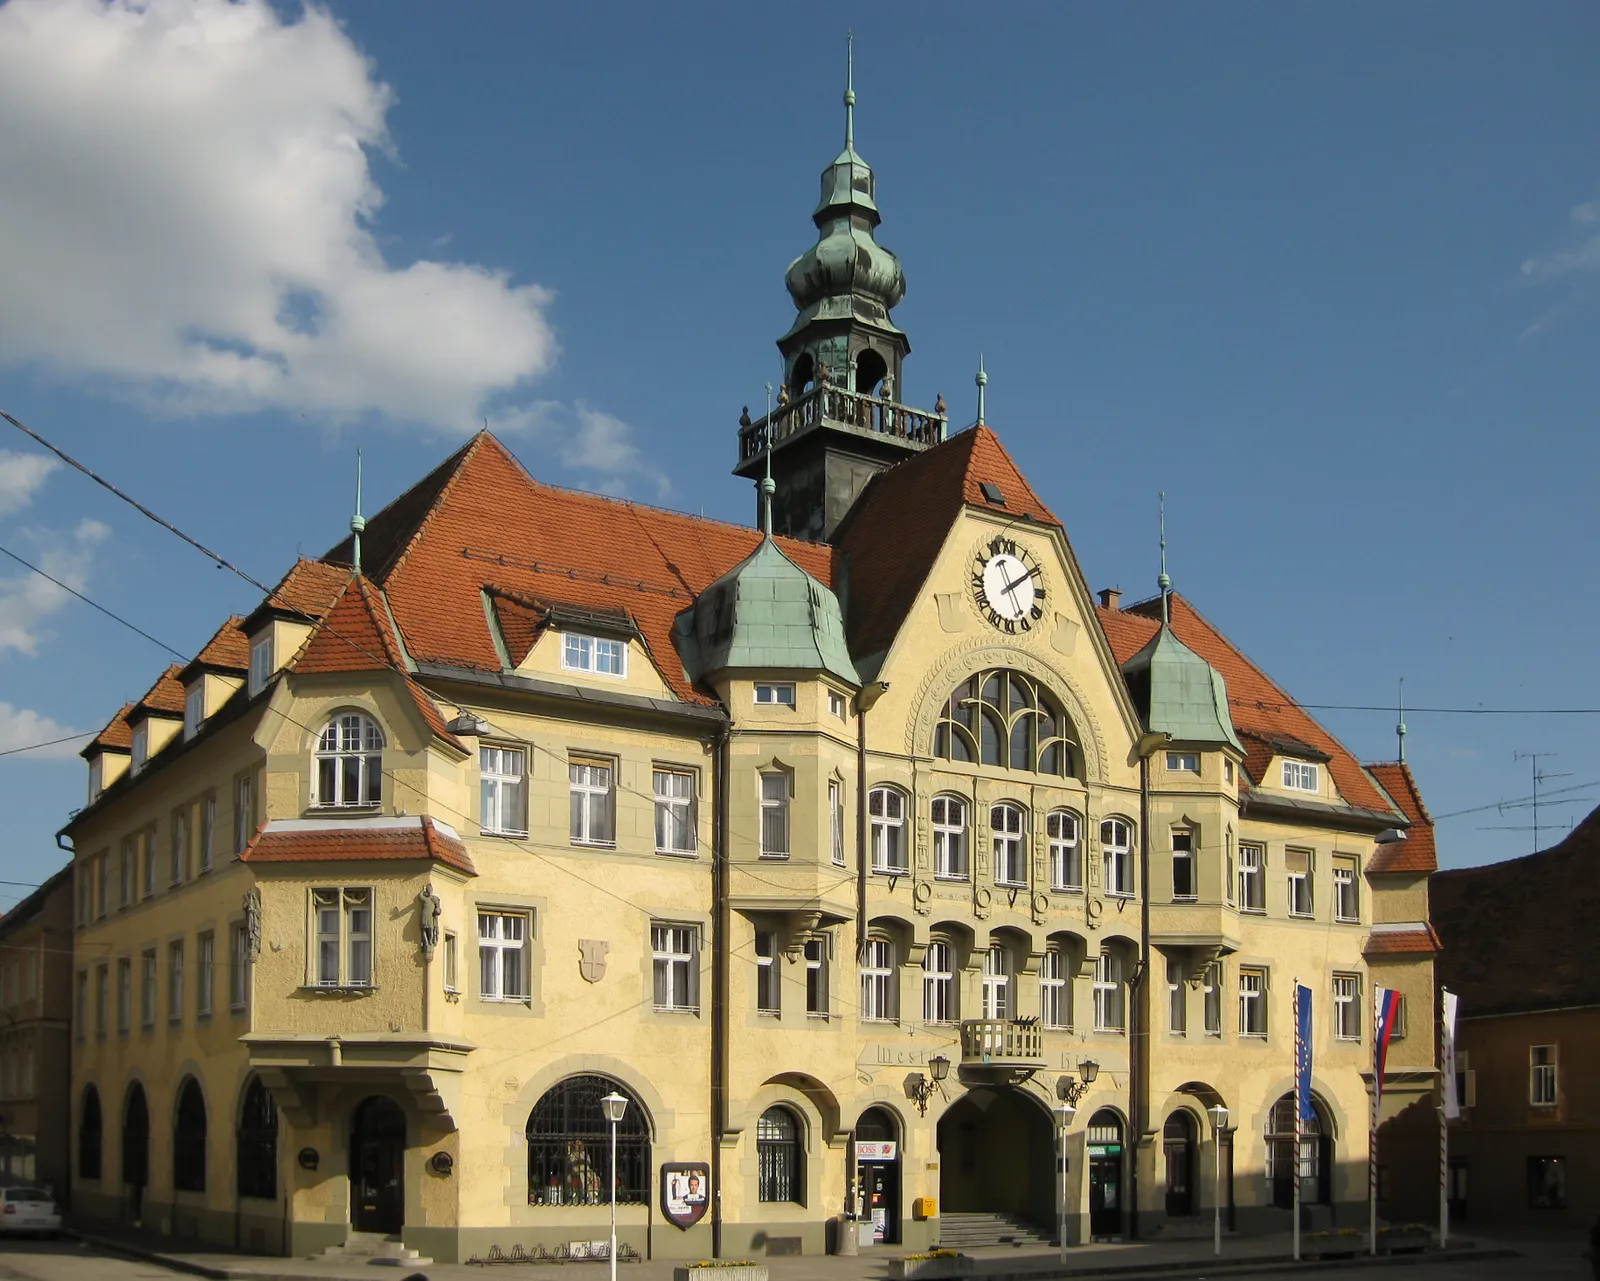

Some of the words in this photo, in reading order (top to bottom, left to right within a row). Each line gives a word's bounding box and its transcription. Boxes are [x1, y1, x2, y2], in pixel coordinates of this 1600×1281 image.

[1003, 539, 1016, 556] XII
[976, 551, 989, 568] X
[972, 571, 985, 588] IX
[1034, 588, 1047, 600] III
[1004, 618, 1016, 635] VI
[1020, 617, 1032, 632] V
[857, 1145, 876, 1154] BOSS
